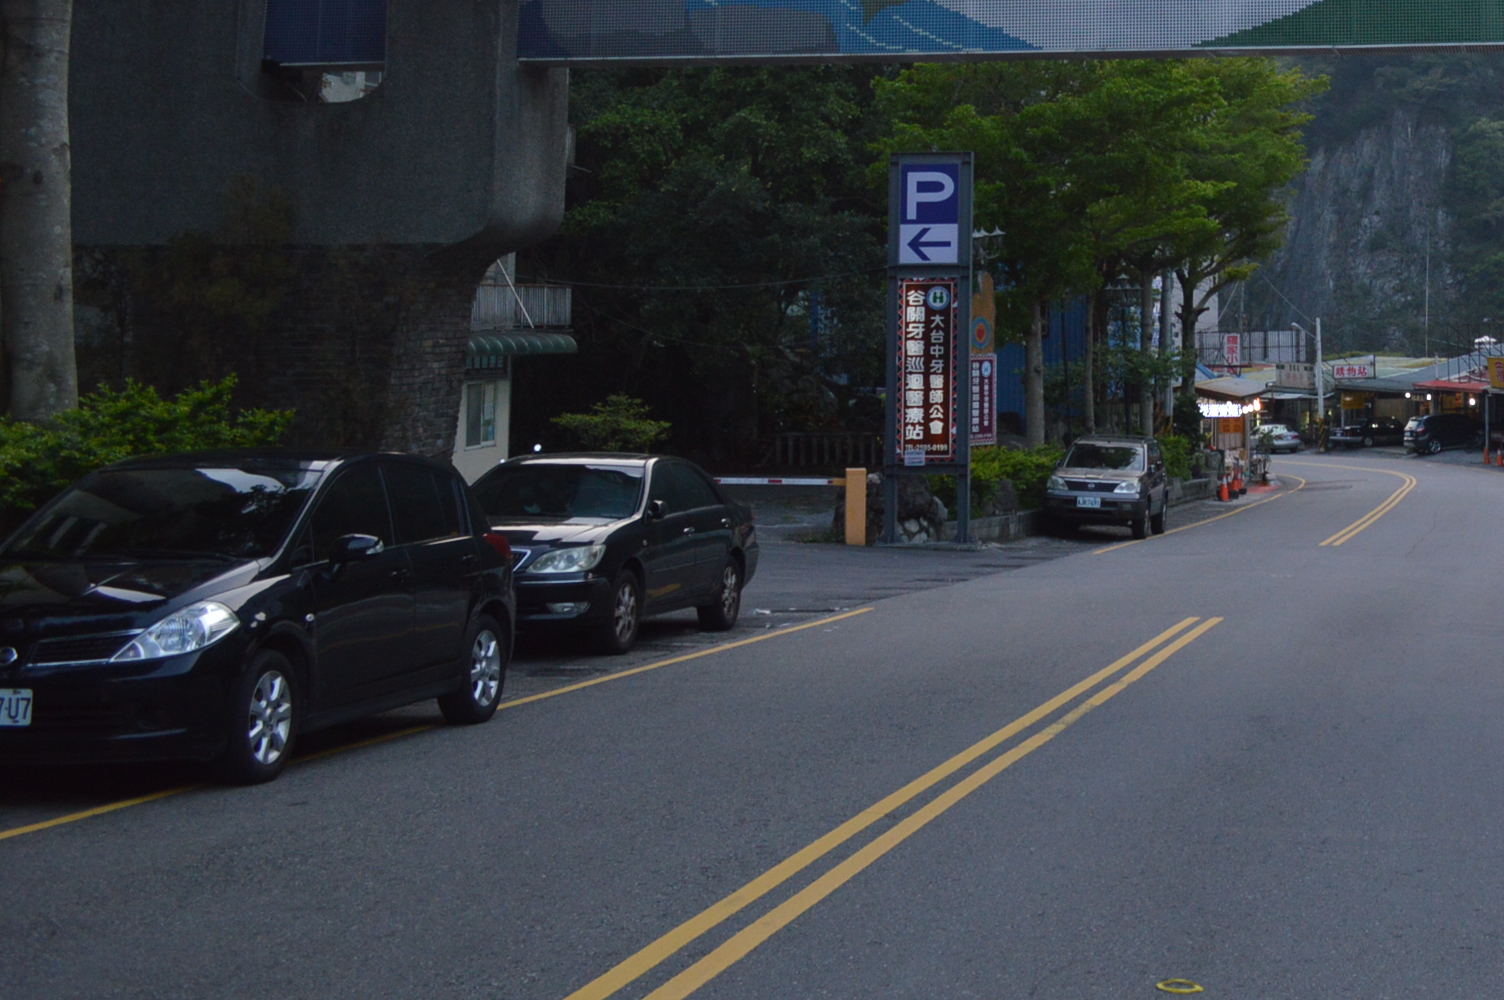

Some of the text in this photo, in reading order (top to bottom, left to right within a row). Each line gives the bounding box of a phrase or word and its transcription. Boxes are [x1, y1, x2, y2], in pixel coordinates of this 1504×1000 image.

[906, 171, 955, 219] P
[905, 290, 925, 440] 谷關牙醫巡迴醫療站
[929, 314, 944, 434] 大台中牙醫師公會
